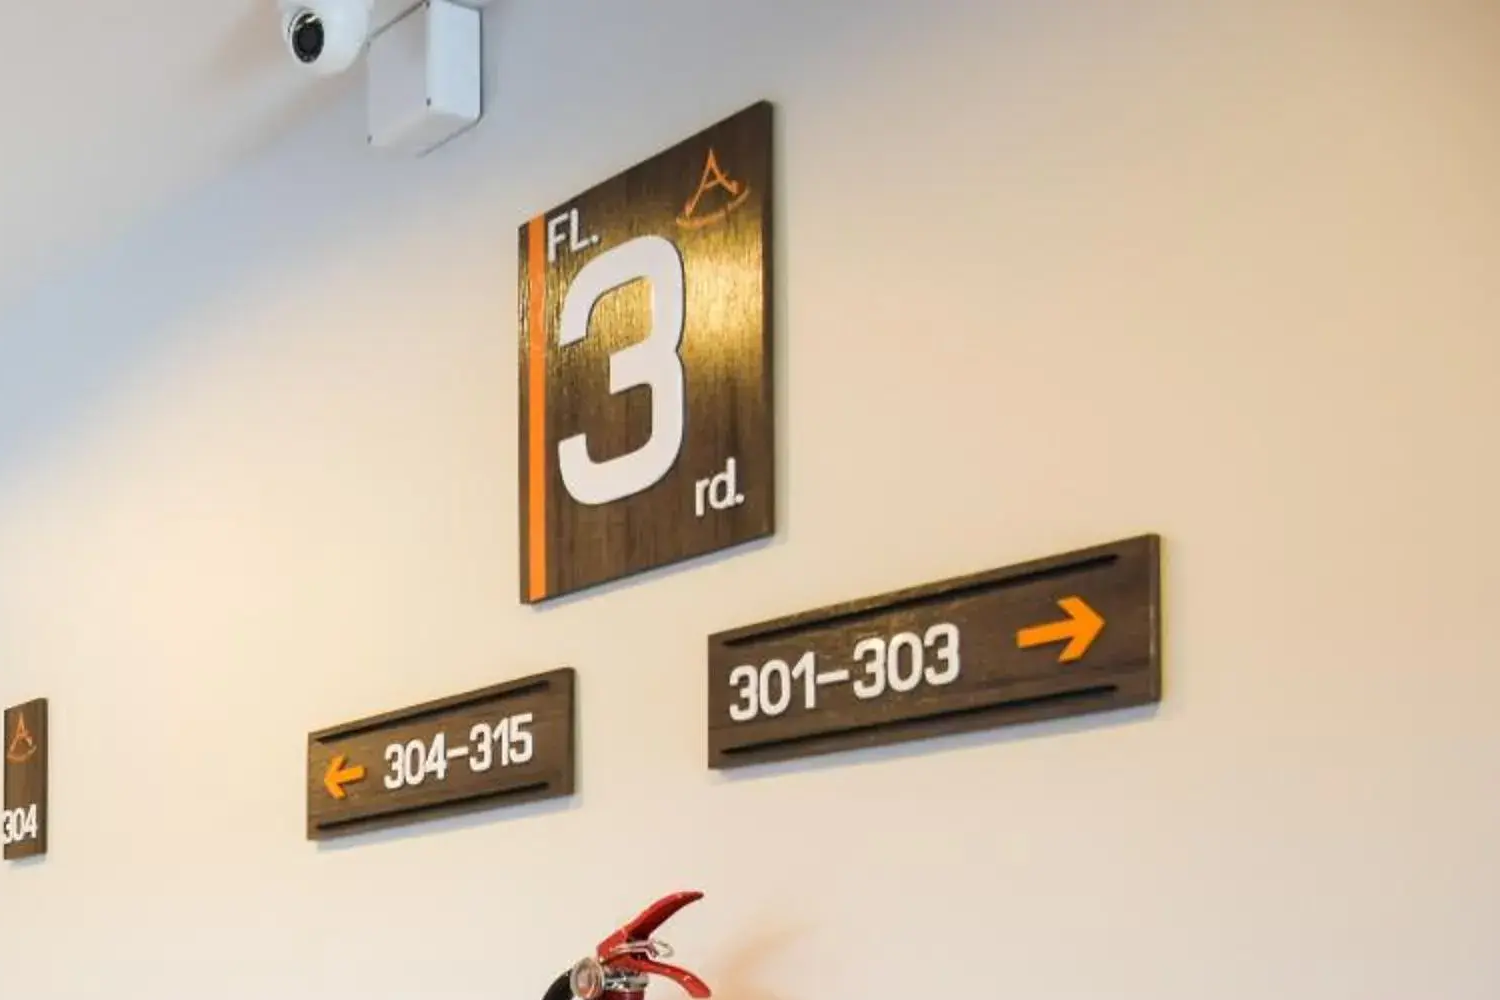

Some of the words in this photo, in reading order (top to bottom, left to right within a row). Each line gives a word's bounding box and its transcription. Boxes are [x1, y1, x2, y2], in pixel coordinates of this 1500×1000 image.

[548, 207, 599, 263] FL.
[558, 235, 686, 506] 3
[695, 457, 746, 517] rd.
[729, 622, 961, 722] 301-303
[383, 711, 534, 790] 304-315
[2, 803, 38, 844] 304
